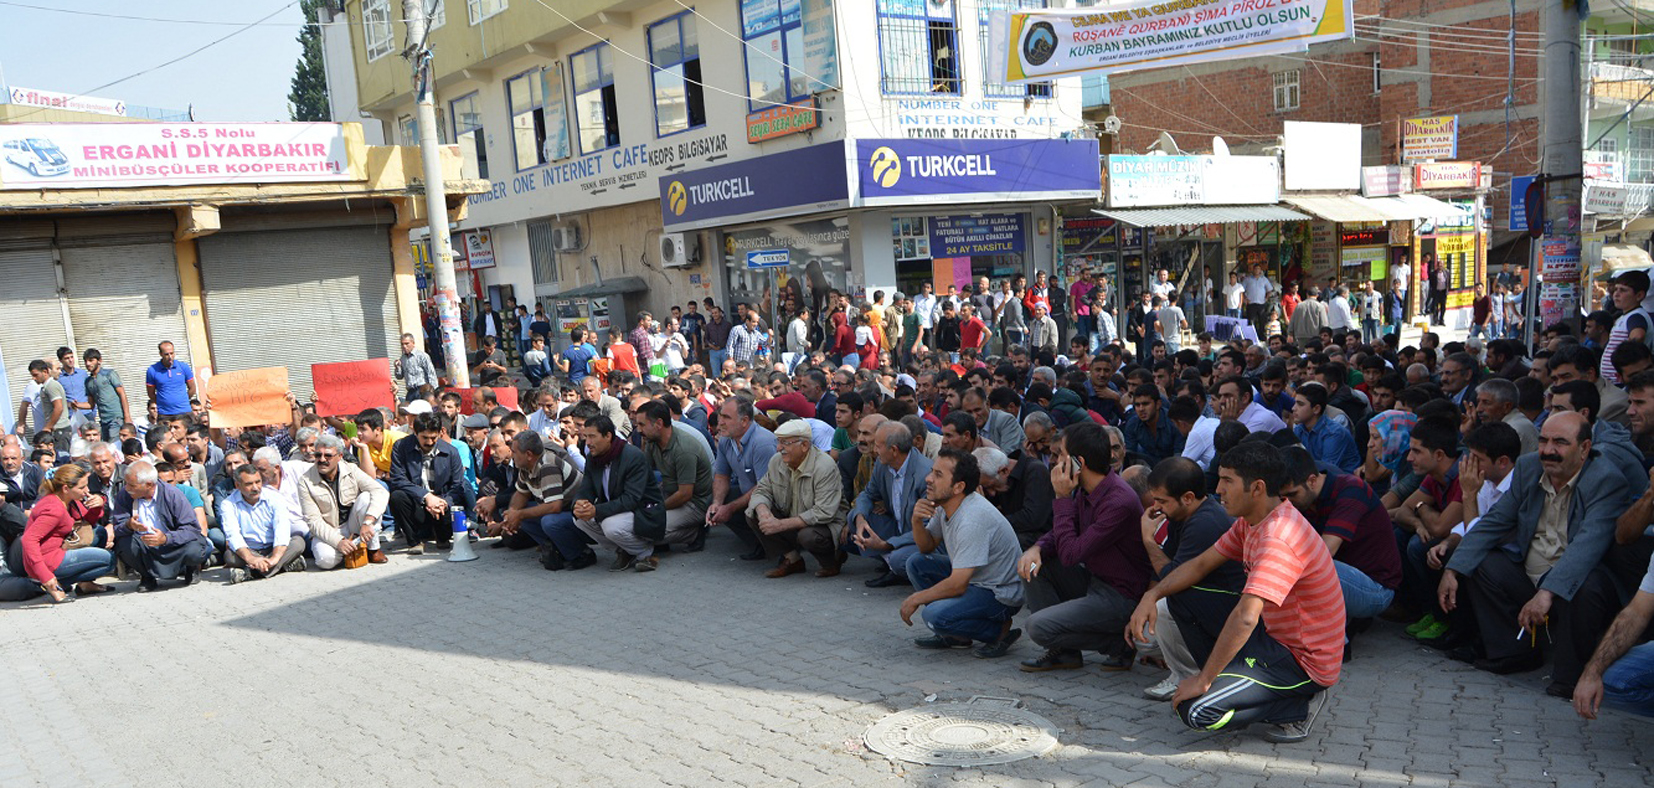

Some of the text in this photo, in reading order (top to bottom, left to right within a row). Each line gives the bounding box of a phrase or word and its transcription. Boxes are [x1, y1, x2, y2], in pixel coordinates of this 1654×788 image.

[1068, 5, 1311, 58] KURBAN BAYRAMINIZ KUTLU OLSUN
[899, 100, 999, 111] NUMBER ONE
[1013, 116, 1058, 126] CAFE
[1422, 118, 1440, 126] HAS
[215, 127, 256, 139] Nolu
[83, 141, 328, 161] ERGANİ DİYARBAKIR
[648, 145, 676, 168] KEOPS
[73, 160, 342, 178] MİNİBÜSÇÜLER KOOPERATİFİ
[513, 173, 536, 195] ONE
[612, 143, 648, 170] CAFE
[906, 154, 997, 178] TURKCELL
[1113, 159, 1154, 174] DİYAR
[689, 175, 755, 206] TURKCELL
[946, 241, 1014, 255] 24 AY TAKSİTLE
[230, 389, 263, 404] HPG
